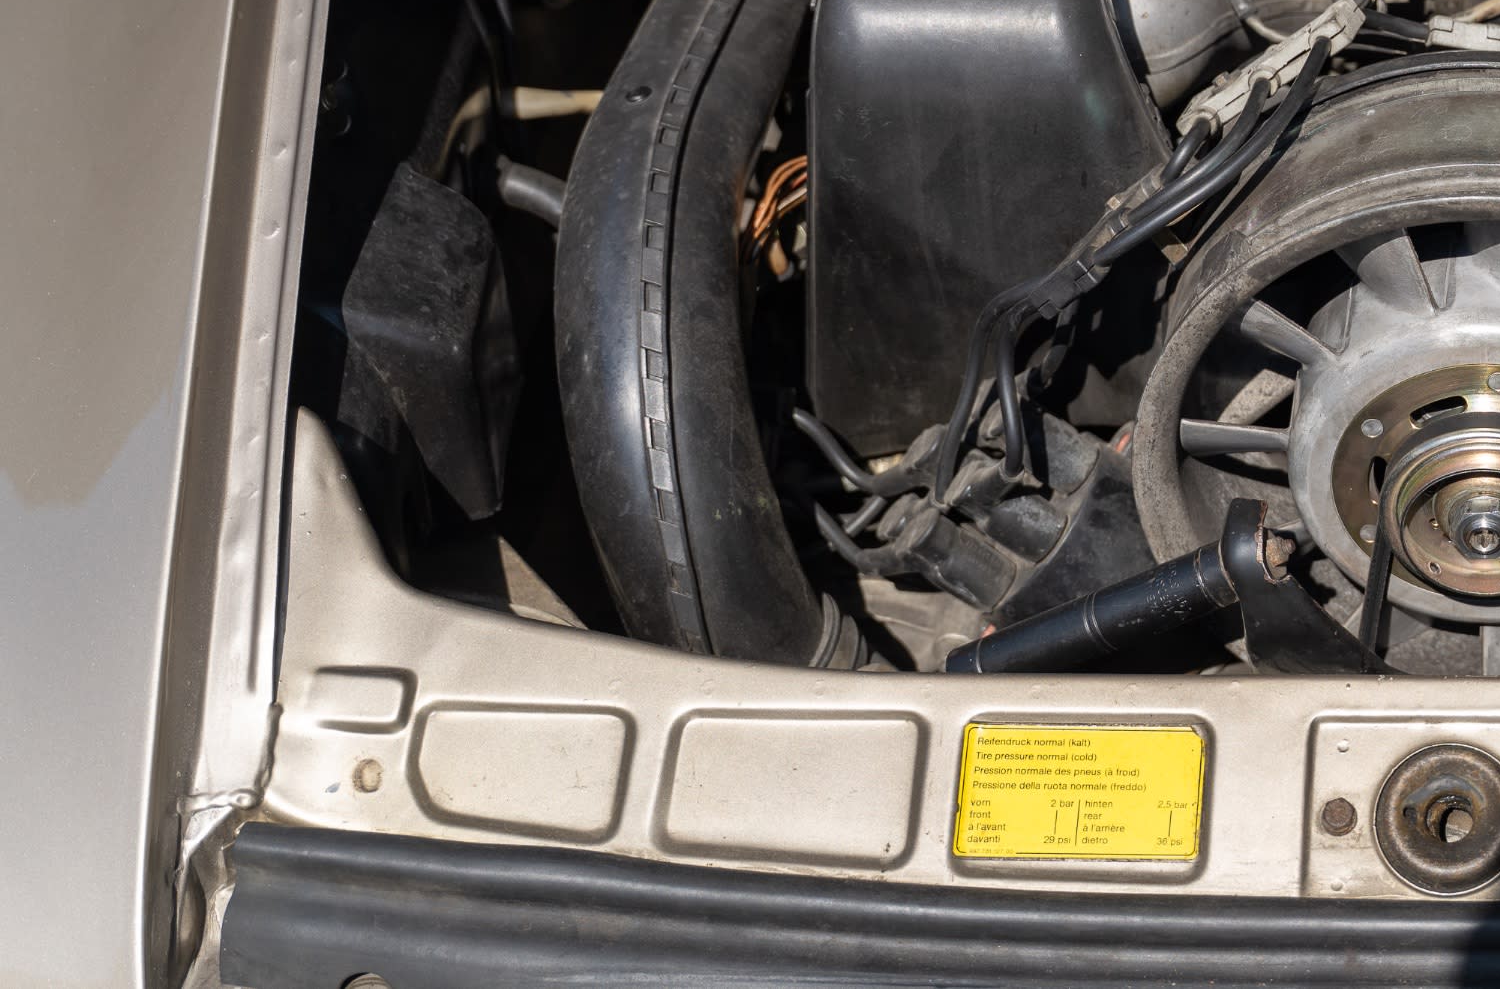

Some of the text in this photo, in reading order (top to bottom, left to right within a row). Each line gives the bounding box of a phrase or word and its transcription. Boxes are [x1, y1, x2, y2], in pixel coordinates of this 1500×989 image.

[978, 738, 1091, 747] Reifendruck normal (kalt)
[976, 752, 992, 760] Tire
[1071, 754, 1097, 762] (cold)
[974, 767, 1013, 775] Pression
[1055, 768, 1071, 776] des
[1074, 769, 1101, 777] pneus
[1105, 769, 1113, 777] (à
[1116, 769, 1140, 777] froid)
[973, 781, 1016, 790] Pressione
[1020, 782, 1041, 790] della
[1071, 783, 1107, 791] normale
[1110, 783, 1147, 792] (freddo)
[1060, 800, 1074, 808] bar
[977, 823, 1006, 831] l'avant
[967, 835, 1001, 843] davanti
[1043, 836, 1055, 844] 29
[1171, 838, 1183, 847] psi
